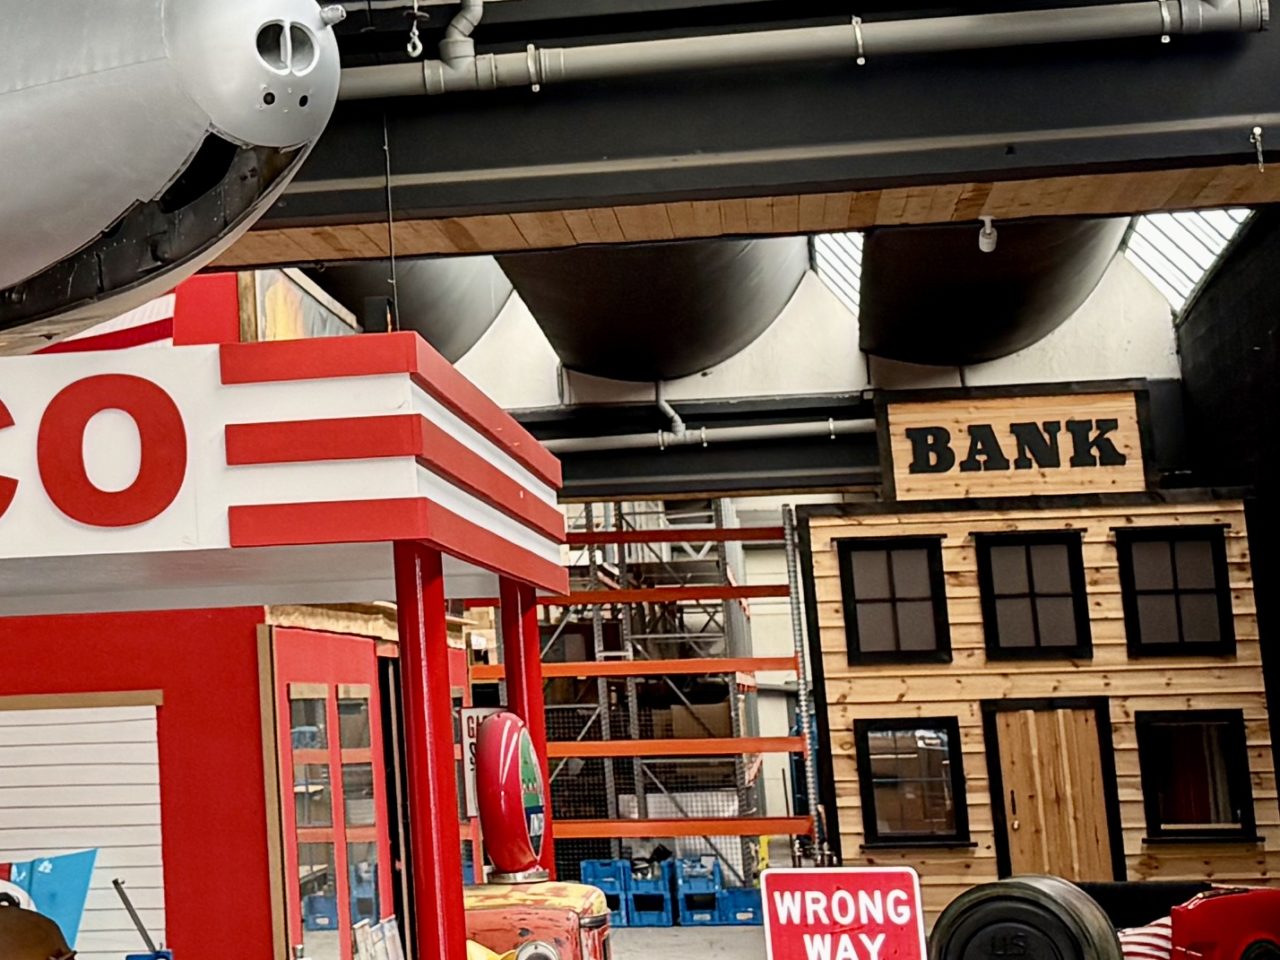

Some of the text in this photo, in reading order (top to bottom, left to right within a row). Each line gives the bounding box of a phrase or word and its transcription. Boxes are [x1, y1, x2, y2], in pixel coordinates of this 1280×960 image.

[905, 418, 1127, 474] BANK
[773, 889, 912, 925] WRONG
[803, 933, 887, 960] WAY
